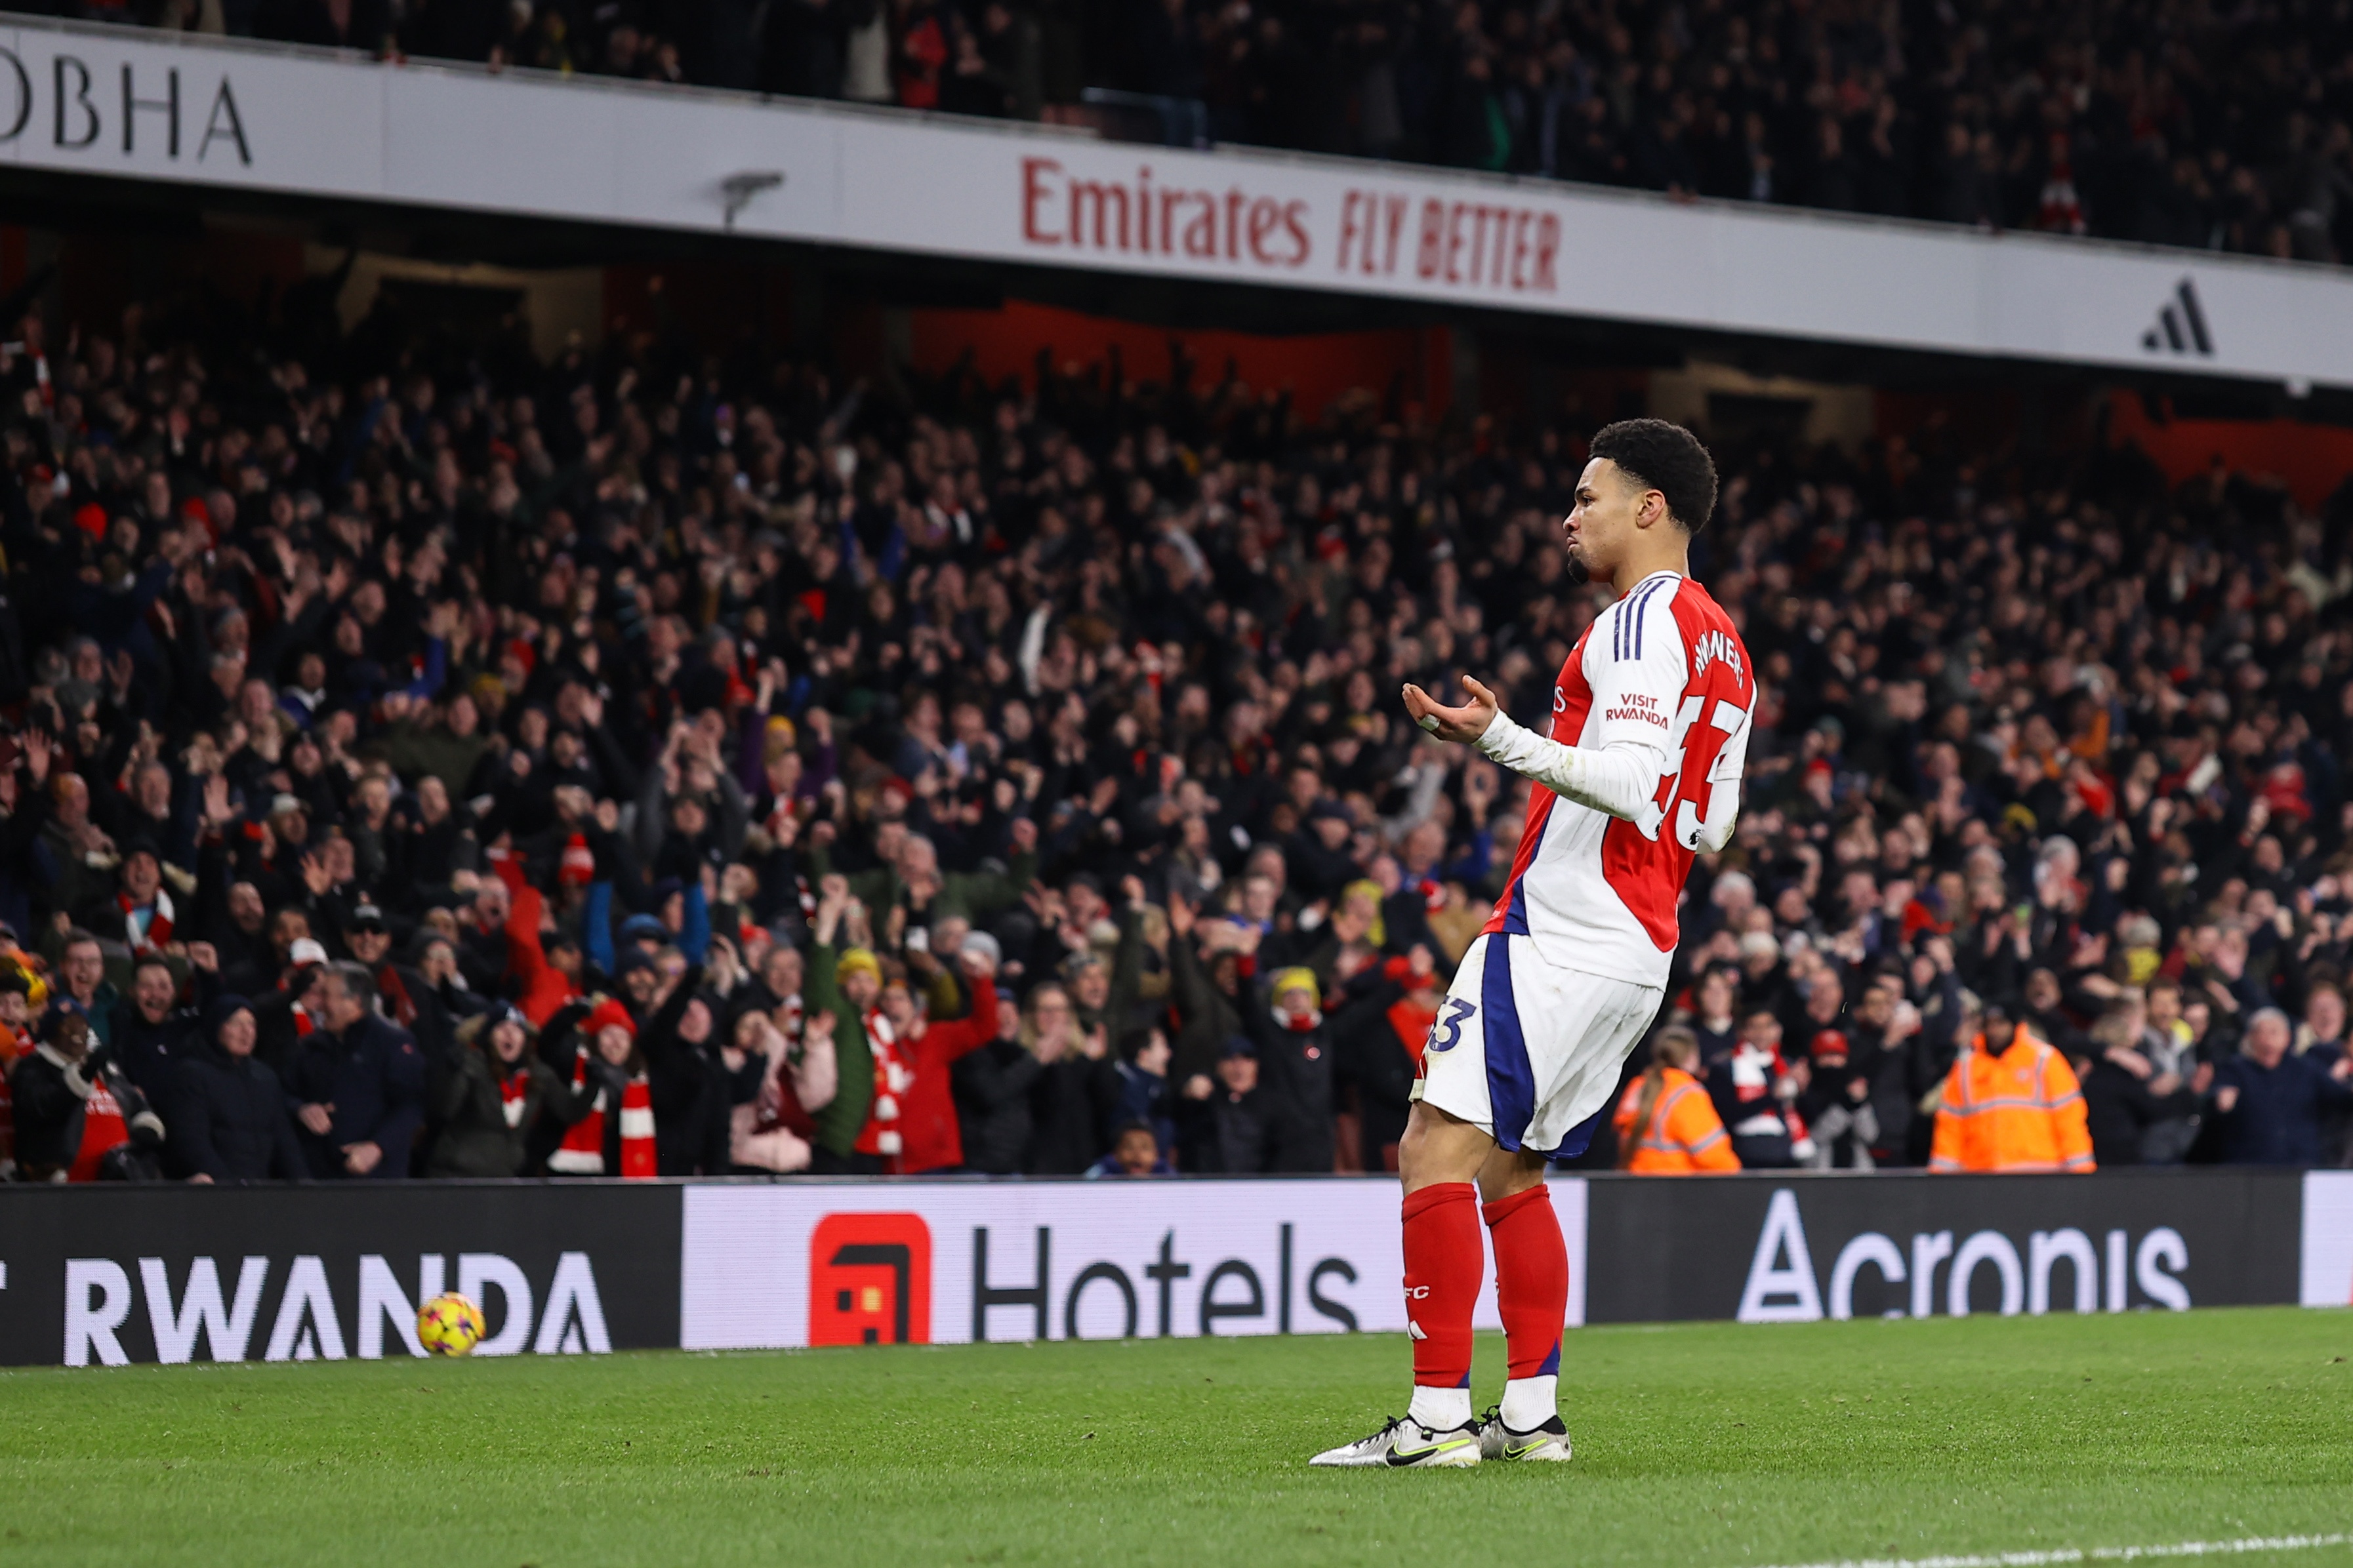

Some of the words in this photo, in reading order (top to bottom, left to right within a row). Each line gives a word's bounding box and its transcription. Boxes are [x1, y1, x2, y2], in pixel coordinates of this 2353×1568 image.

[1019, 155, 1311, 268] Emirates
[1336, 188, 1409, 275] FLY
[1416, 197, 1563, 294] BETTER
[1606, 708, 1668, 731] RWANDA
[1620, 693, 1658, 710] VISIT
[1429, 995, 1477, 1052] 3
[64, 1251, 613, 1367] RWANDA
[973, 1222, 1358, 1342] Hotels
[1736, 1188, 2192, 1323] Acronis
